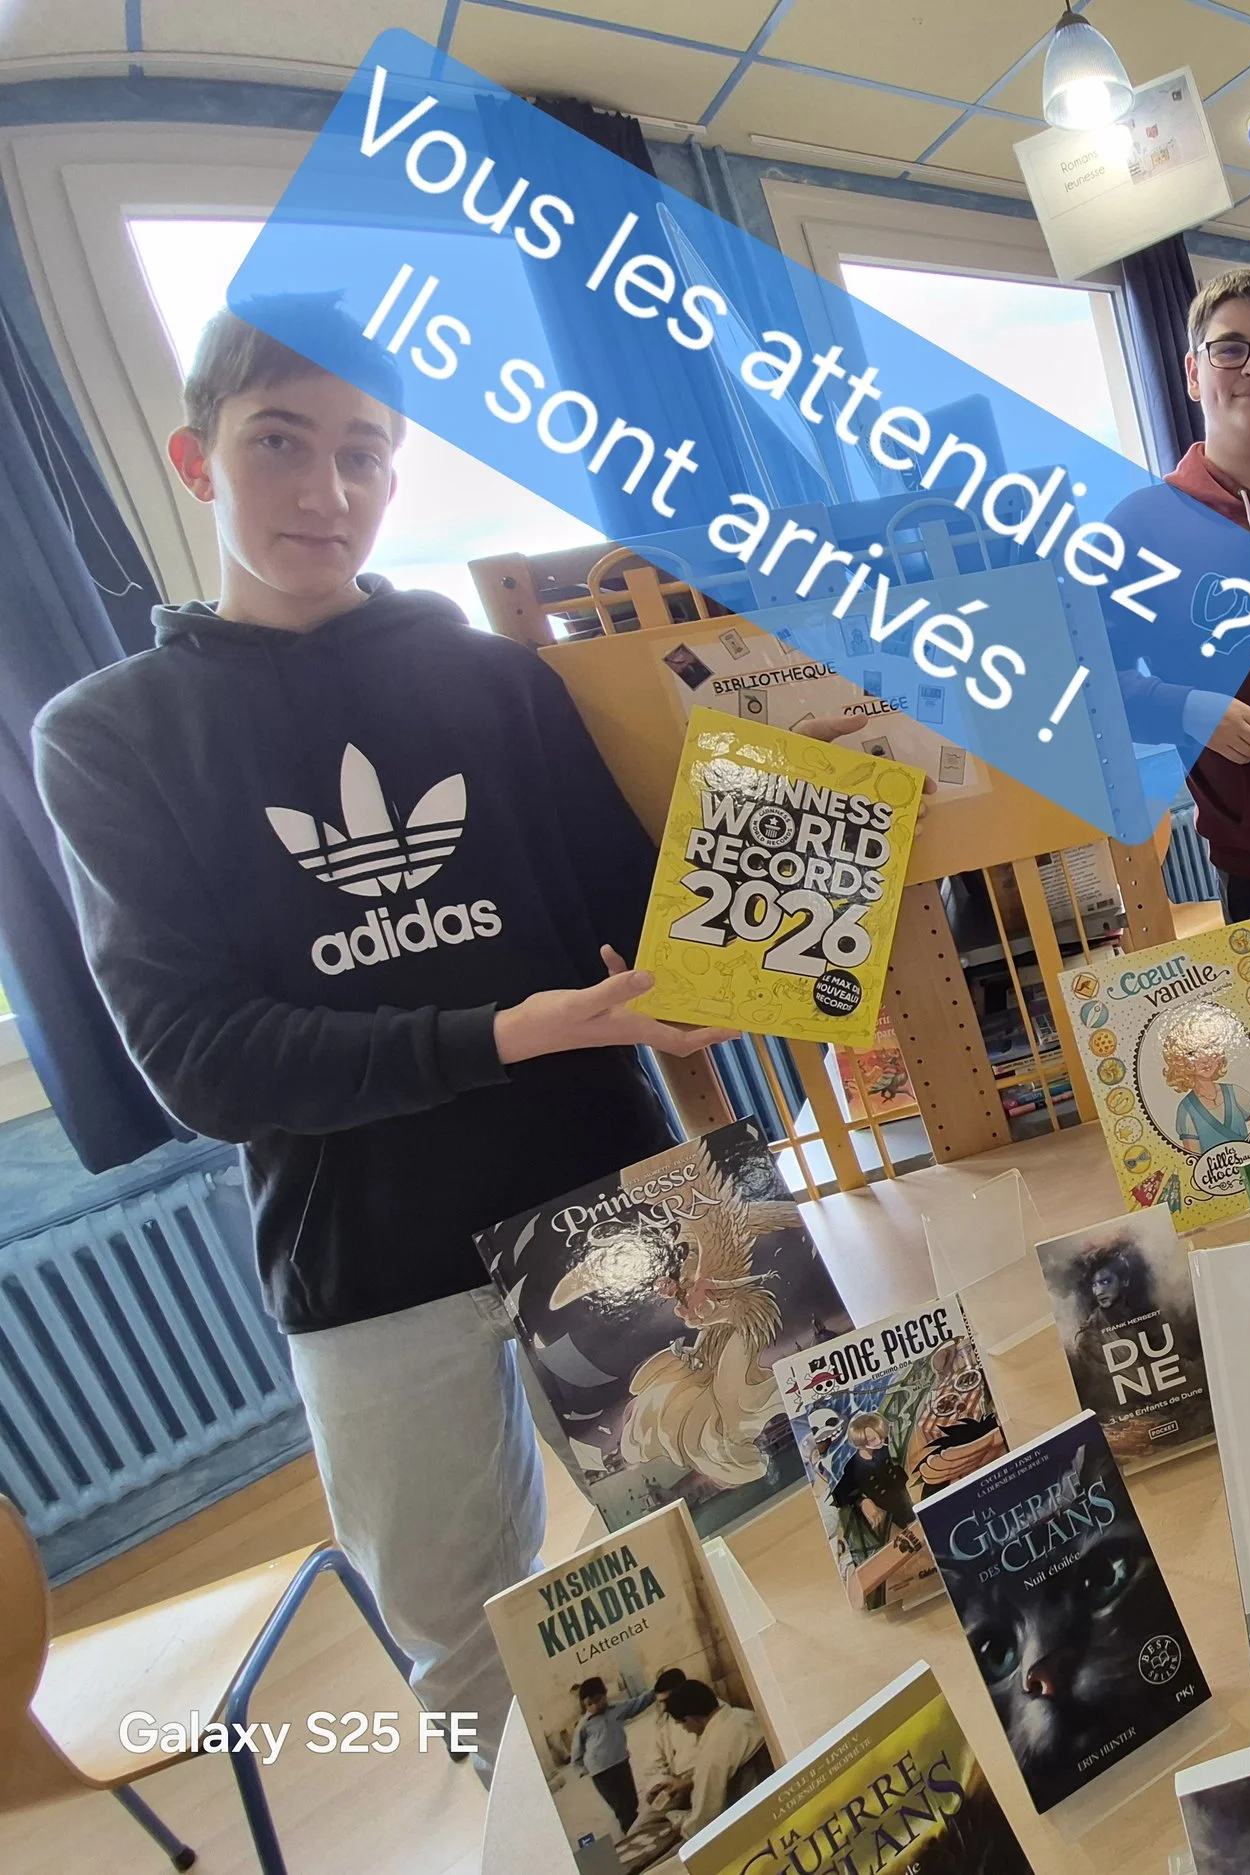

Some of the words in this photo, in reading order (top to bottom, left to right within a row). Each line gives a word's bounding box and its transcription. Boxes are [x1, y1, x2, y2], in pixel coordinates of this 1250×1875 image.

[1060, 149, 1099, 173] Romans
[712, 661, 837, 694] BIBLIOTHEQUE
[685, 827, 886, 901] RECORDS
[310, 899, 503, 976] adidas
[668, 868, 873, 979] 2026
[815, 992, 854, 1012] RECORDS
[822, 974, 832, 982] LE
[831, 976, 852, 990] MAX
[1143, 965, 1231, 1009] vanille
[1201, 1166, 1240, 1185] choco
[551, 1162, 699, 1248] Princesse
[1101, 1322, 1127, 1335] FRANK
[1127, 1309, 1162, 1326] HERBERT
[829, 1337, 881, 1385] ONE
[1102, 1322, 1175, 1374] DU
[1112, 1353, 1187, 1406] NE
[1117, 1410, 1135, 1422] Les
[1135, 1400, 1169, 1417] Enfants
[1169, 1396, 1180, 1405] de
[1180, 1387, 1203, 1402] Dune
[1151, 1423, 1177, 1438] POCKET
[949, 1470, 1086, 1561] GUERRE
[978, 1563, 1001, 1584] DES
[1001, 1474, 1117, 1573] CLANS
[981, 1506, 997, 1521] LA
[537, 1544, 639, 1612] YASMINA
[1023, 1571, 1047, 1592] Nuit
[1048, 1551, 1081, 1577] étoilée
[536, 1565, 667, 1659] KHADRA
[575, 1617, 651, 1666] L'Attentat
[1141, 1639, 1172, 1663] BEST
[1147, 1655, 1179, 1681] SELLER
[1077, 1752, 1100, 1772] ERIN
[1099, 1726, 1137, 1758] HUNTER
[822, 1749, 966, 1875] LANS
[780, 1827, 802, 1851] LA
